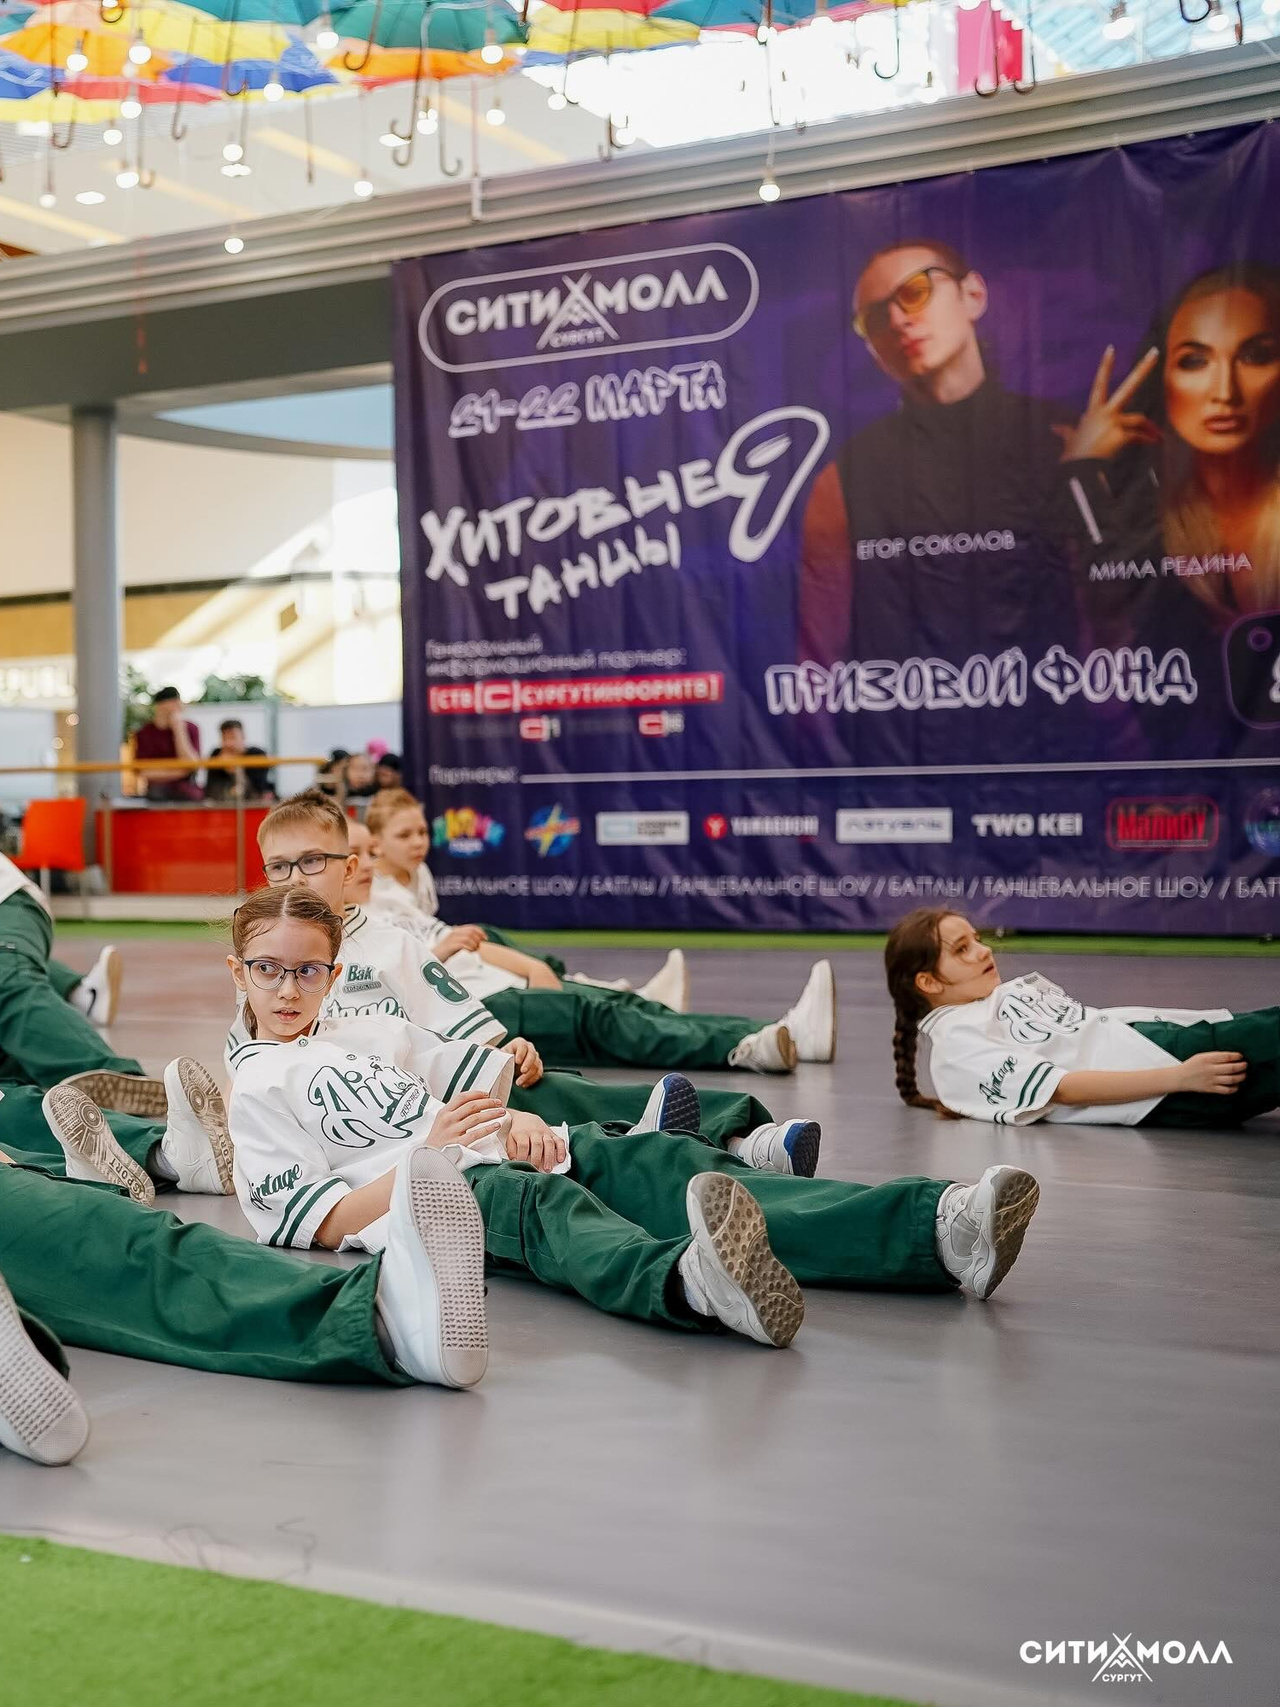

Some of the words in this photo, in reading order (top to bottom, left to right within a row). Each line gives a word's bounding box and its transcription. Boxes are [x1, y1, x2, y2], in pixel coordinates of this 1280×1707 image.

[585, 360, 727, 423] МАРТА
[856, 537, 907, 561] ЕГОР
[908, 529, 1016, 557] СОКОЛОВ
[1089, 559, 1157, 581] МИЛА
[1160, 552, 1253, 578] РЕДИНА
[764, 646, 1028, 715] ПРИЗОВОЙ
[1032, 644, 1198, 707] ФОНД
[971, 812, 1035, 838] TWO
[983, 875, 1151, 899] ТАНЦЕВАЛЬНОЕ
[1154, 876, 1215, 899] ШОУ
[1236, 876, 1280, 899] БАТ
[346, 963, 374, 983] Bak
